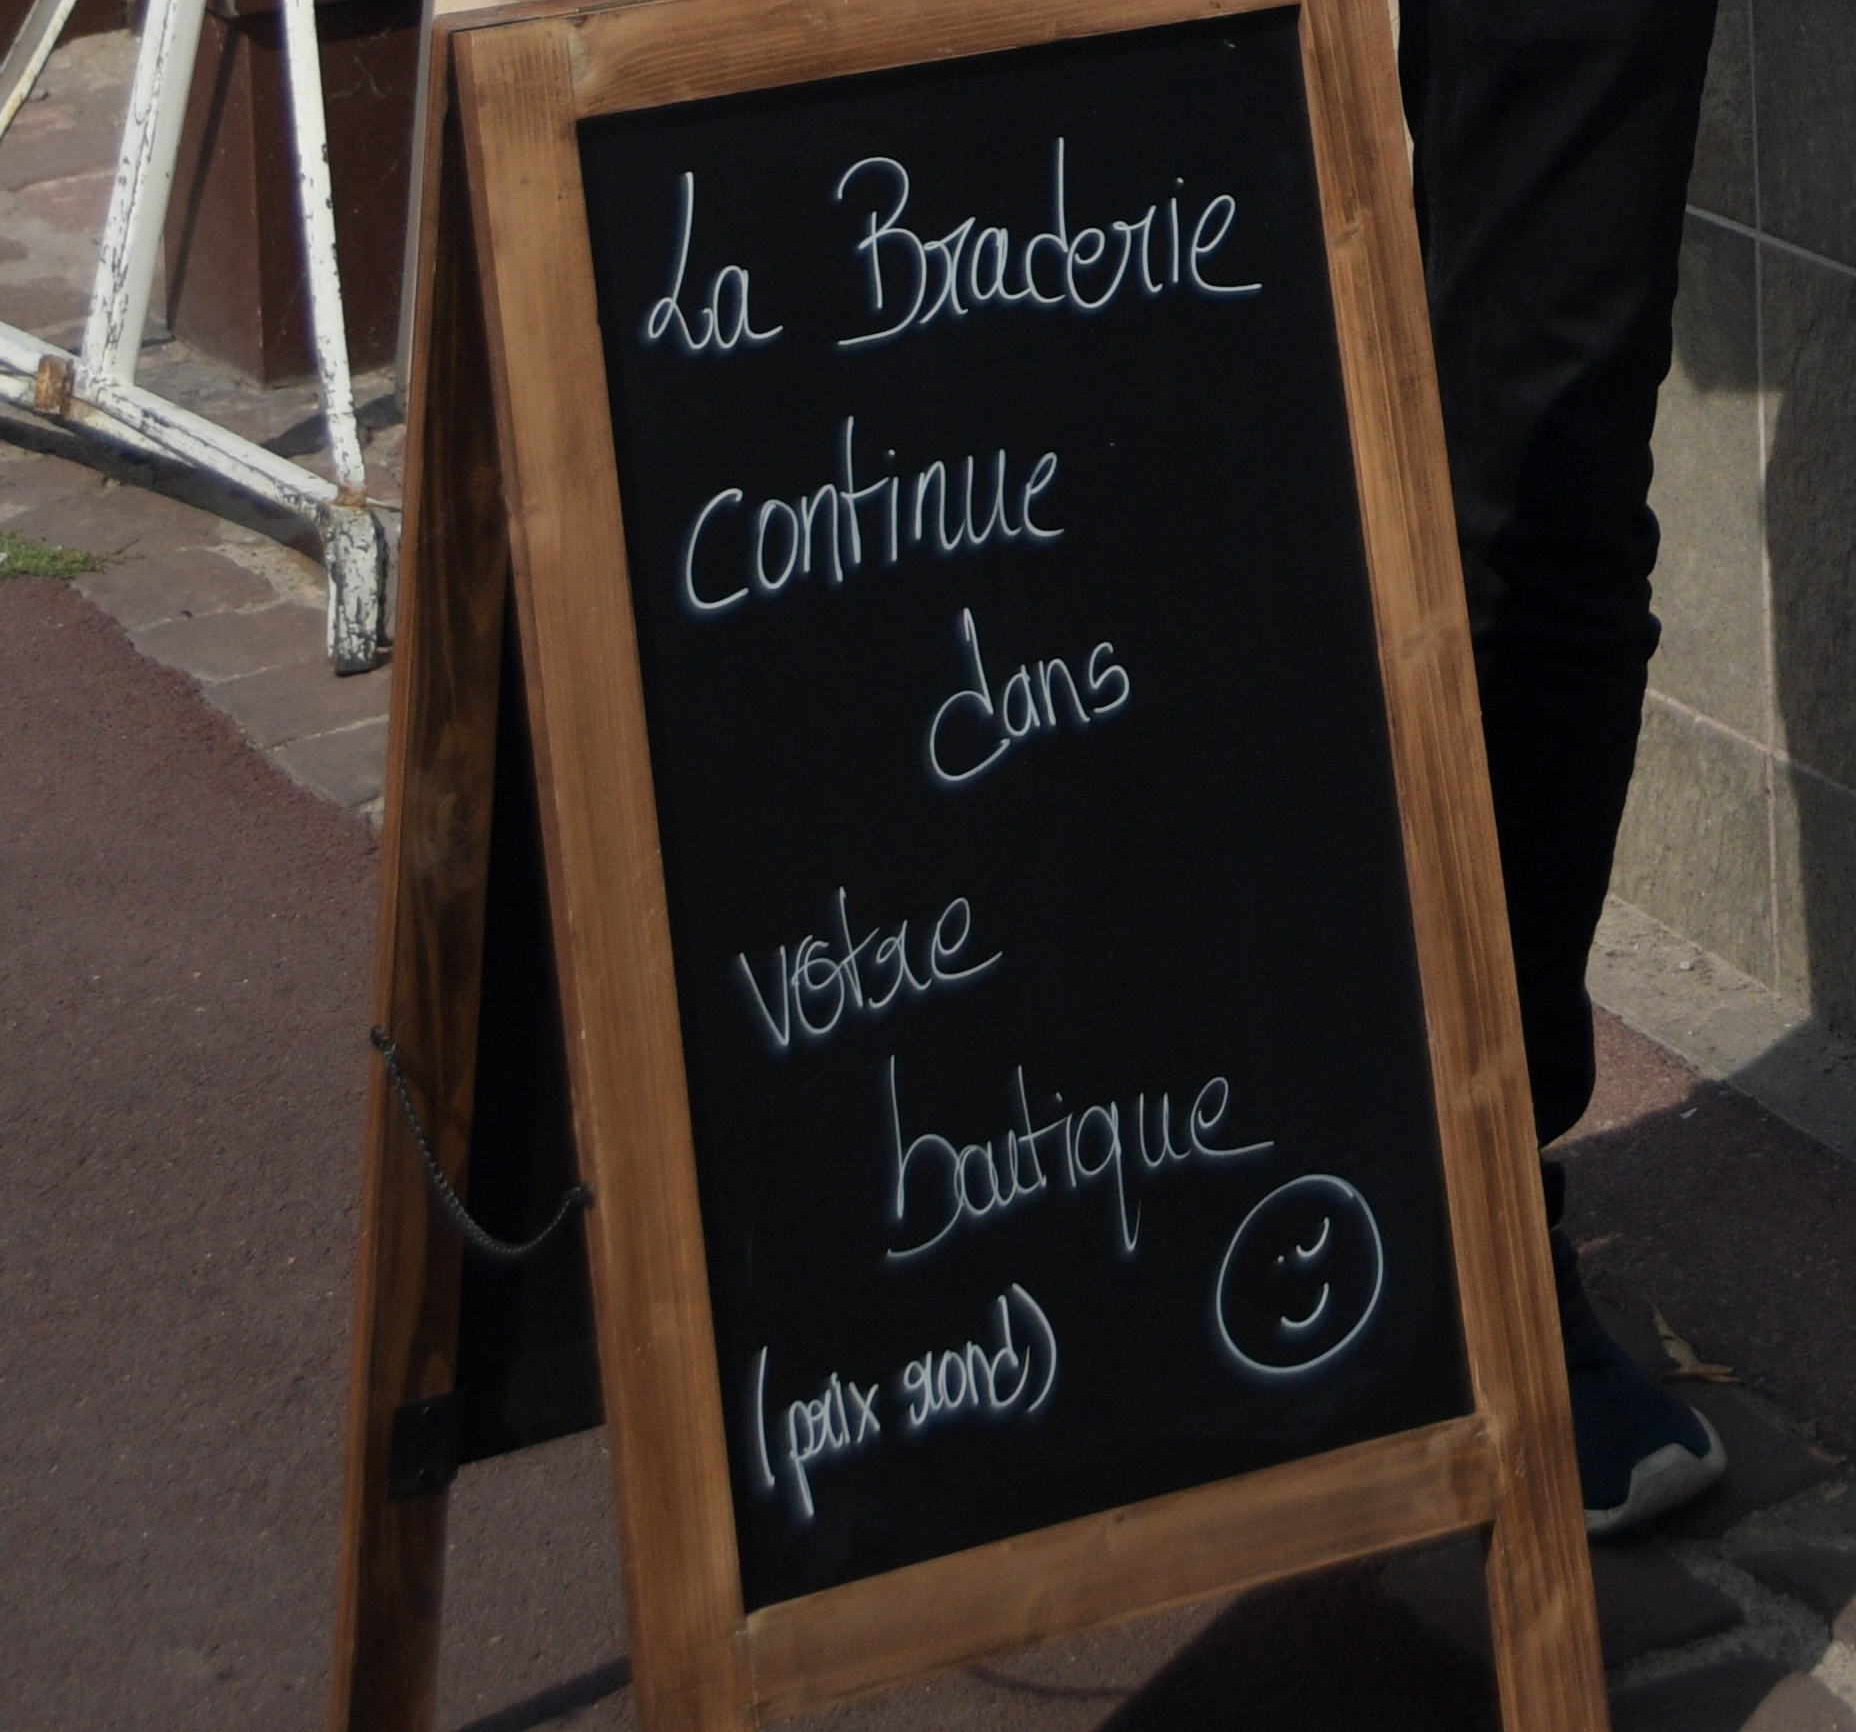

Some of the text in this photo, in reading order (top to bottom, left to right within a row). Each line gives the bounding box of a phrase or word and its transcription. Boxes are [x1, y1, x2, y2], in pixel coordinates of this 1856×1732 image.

[647, 136, 1262, 351] La Braderie
[929, 608, 1131, 782] dans
[739, 886, 1003, 1047] votre
[887, 1054, 1275, 1258] boutique
